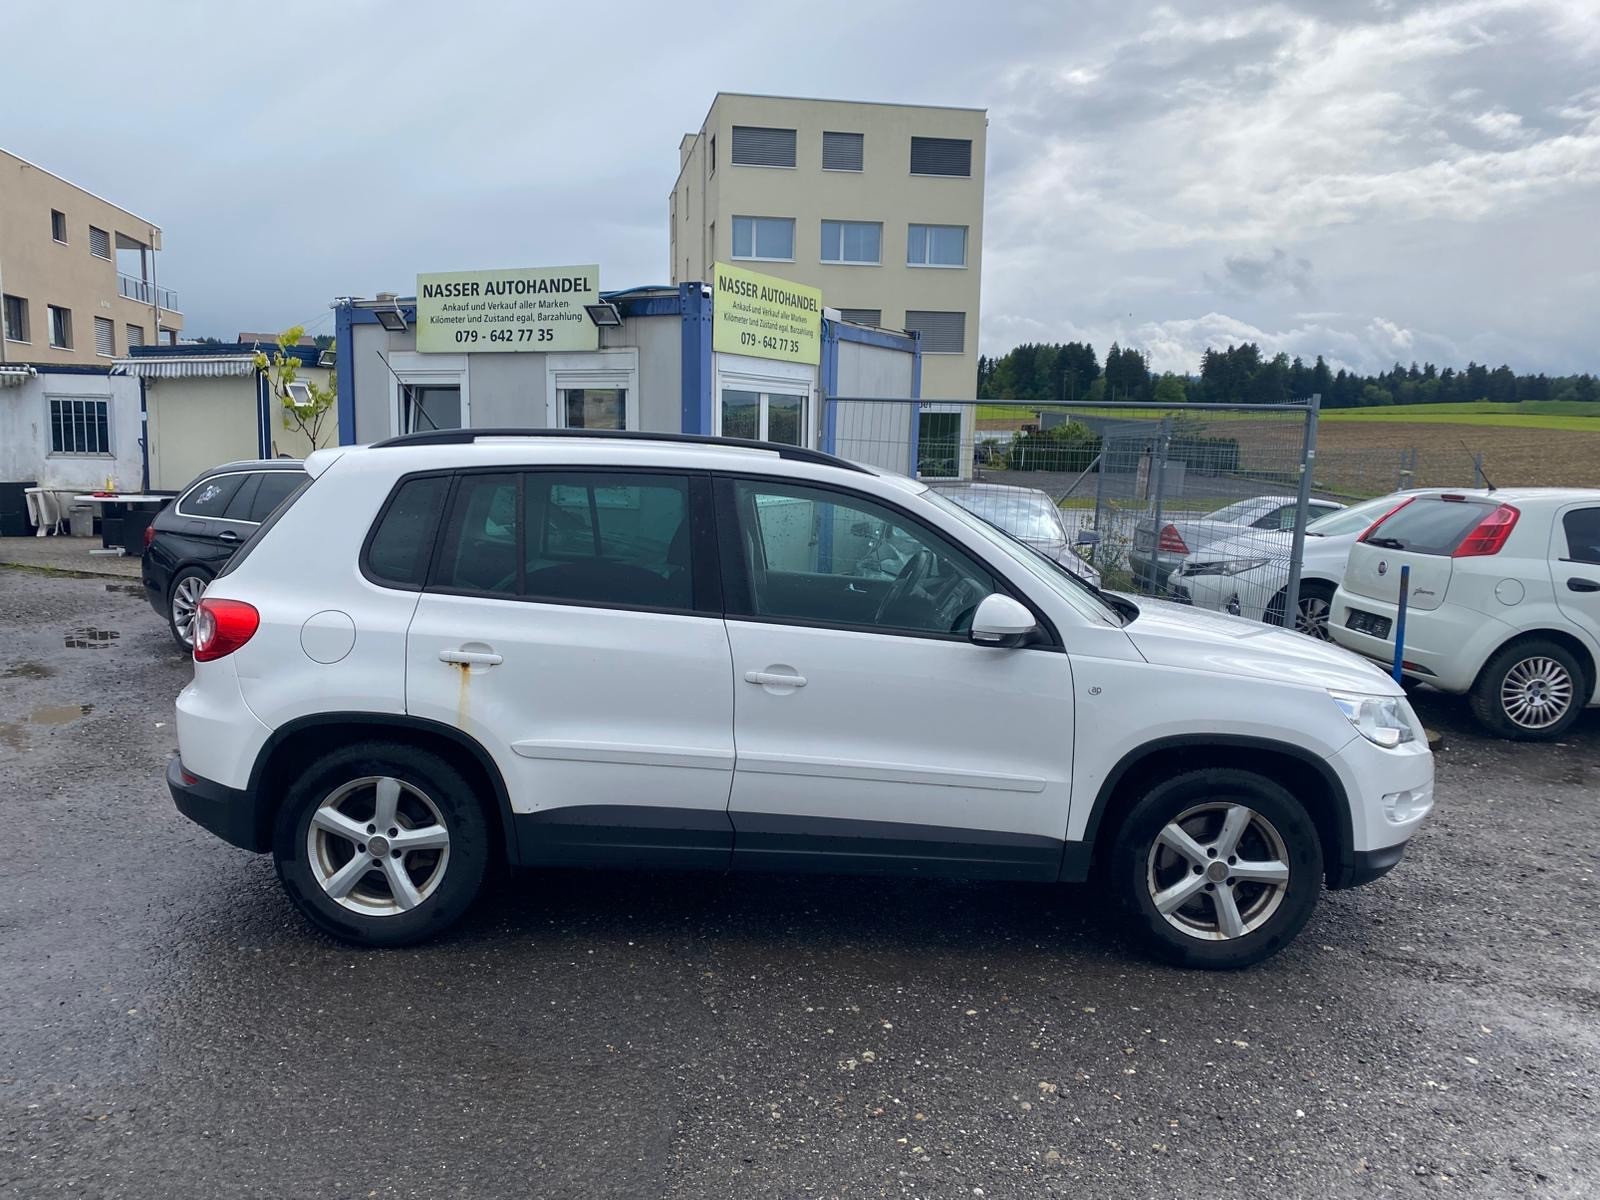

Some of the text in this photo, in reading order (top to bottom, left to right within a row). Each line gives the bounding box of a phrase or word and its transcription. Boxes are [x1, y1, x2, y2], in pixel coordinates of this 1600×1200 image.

[423, 277, 591, 298] NASSER AUTOHANDEL
[719, 276, 818, 312] NASSER AUTOHANDEL
[488, 302, 517, 310] Verkauf
[539, 300, 569, 308] Marken
[733, 302, 807, 323] Ankauf und Verkauf aller Marken
[431, 316, 465, 324] Kilometer
[484, 314, 514, 322] Zustand
[538, 312, 582, 322] Barzahlung
[724, 313, 748, 324] Kilometer
[750, 318, 758, 326] und
[760, 319, 777, 329] Zustand
[790, 326, 813, 338] Barzahlung
[455, 330, 478, 342] 079
[490, 330, 512, 342] 642
[518, 329, 533, 341] 77
[538, 329, 553, 341] 35
[741, 332, 755, 346] 079
[763, 336, 777, 349] 642
[780, 339, 788, 351] 77
[790, 341, 799, 352] 35
